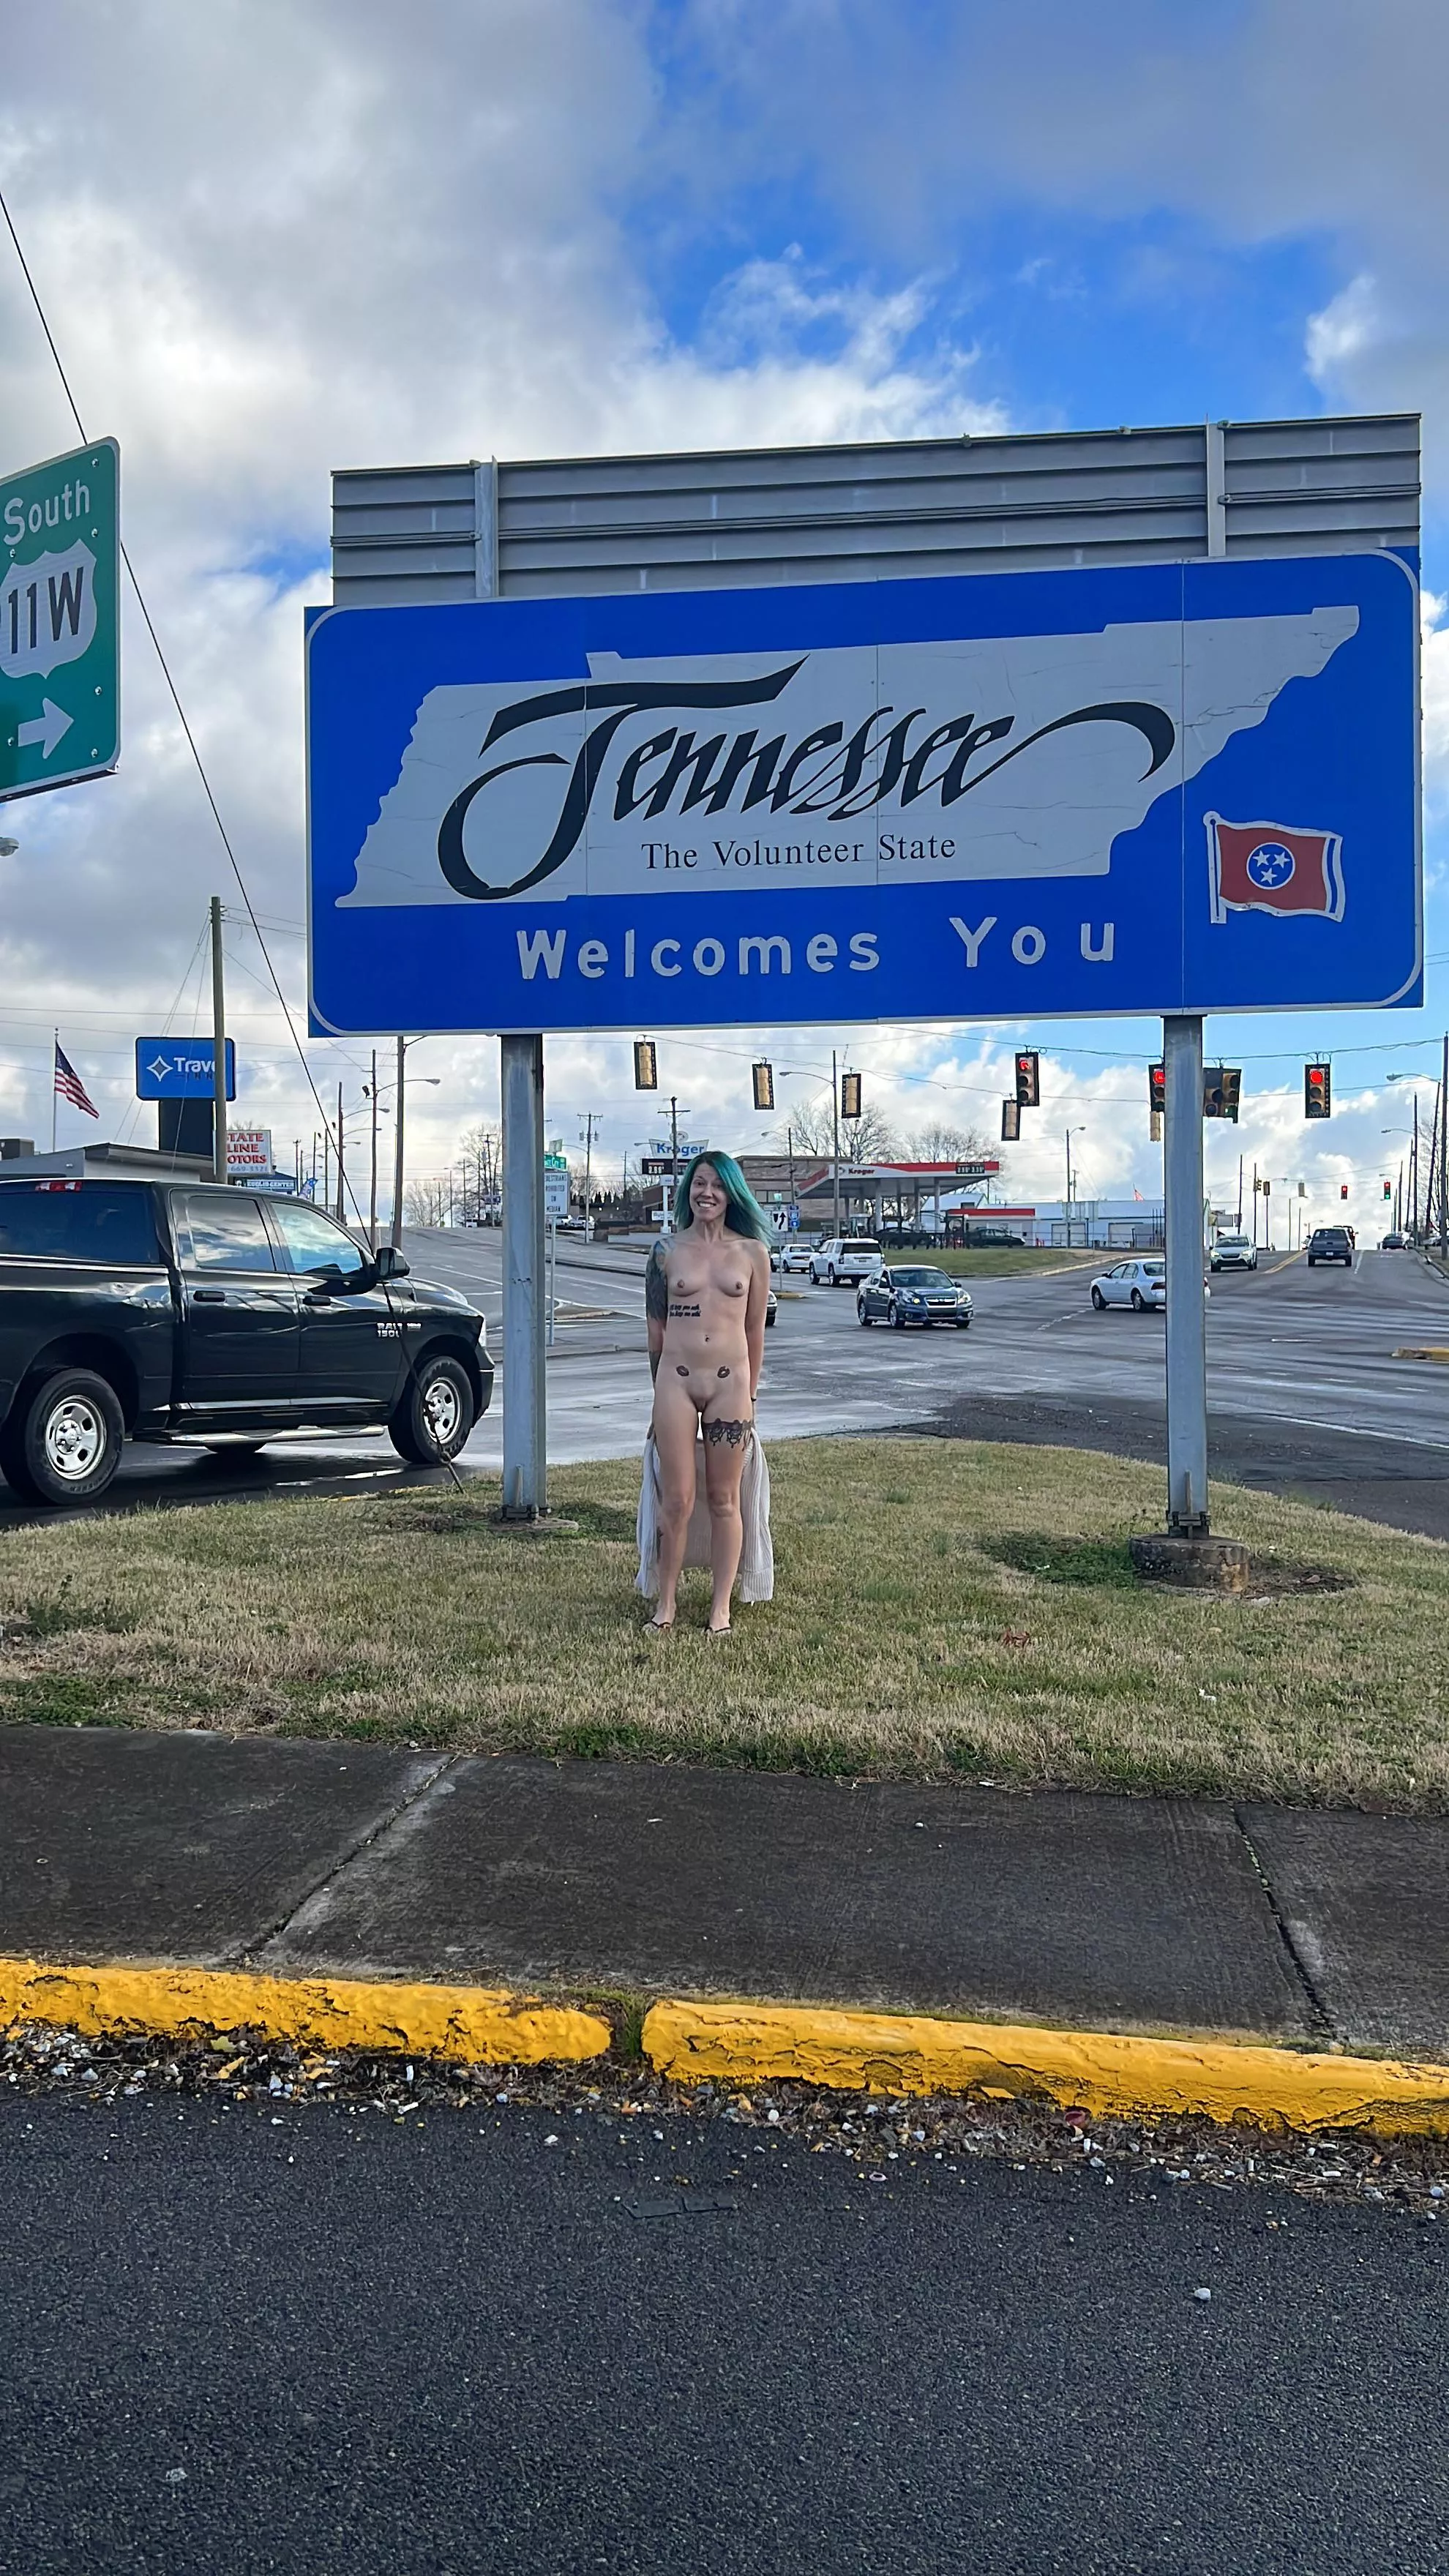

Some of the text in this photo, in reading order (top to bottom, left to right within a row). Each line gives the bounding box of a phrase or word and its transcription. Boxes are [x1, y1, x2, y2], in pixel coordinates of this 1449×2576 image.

[3, 479, 90, 546] South
[7, 566, 84, 654] 11W
[438, 653, 1175, 900] Tennessee
[641, 834, 956, 870] The Volunteer State
[516, 916, 1115, 980] Welcomes You
[227, 1132, 264, 1142] TATE
[227, 1143, 259, 1153] LINE
[227, 1154, 267, 1164] OTORS
[848, 1167, 875, 1175] Kroger
